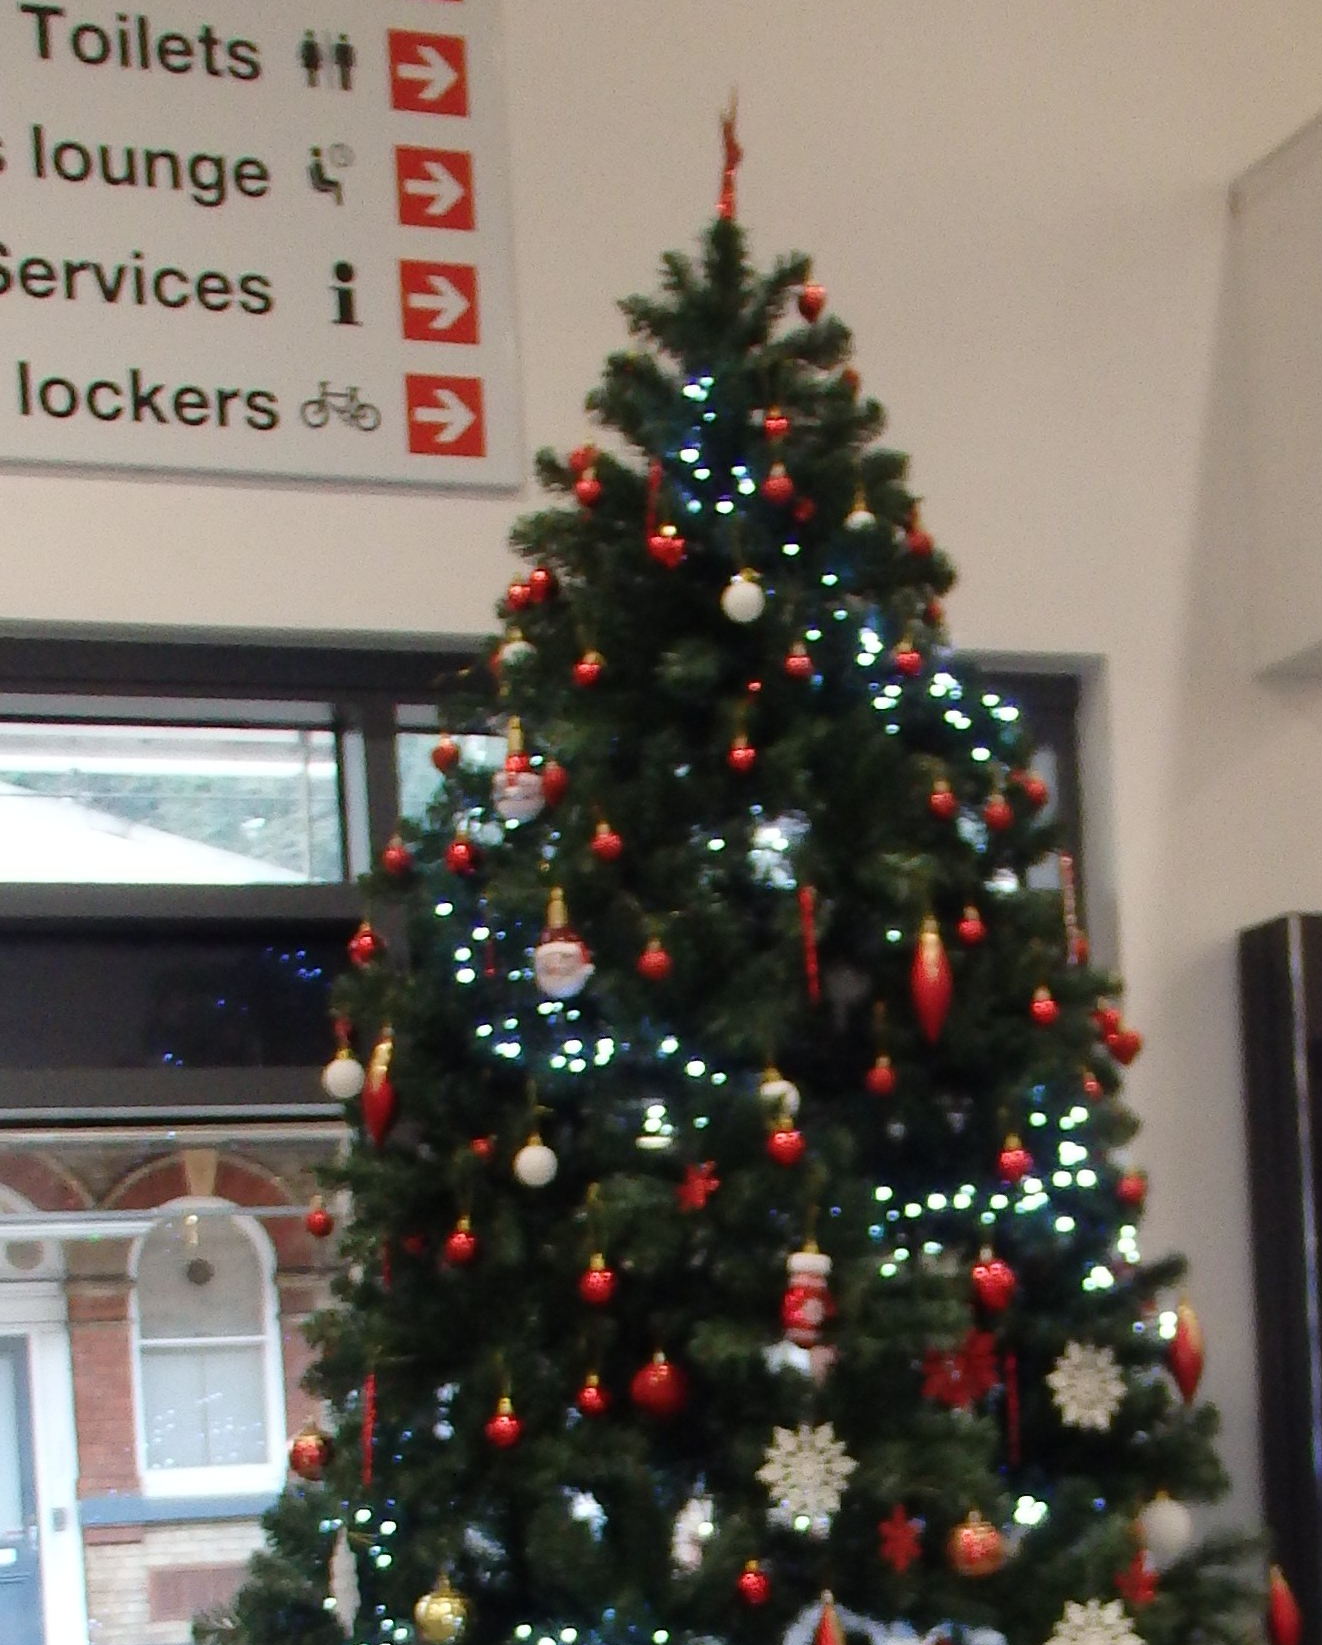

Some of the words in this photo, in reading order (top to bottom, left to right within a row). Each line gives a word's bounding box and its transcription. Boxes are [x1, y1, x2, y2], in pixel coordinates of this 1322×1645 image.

[19, 2, 263, 82] Toilets
[31, 123, 271, 208] lounge
[16, 360, 281, 432] lockers
